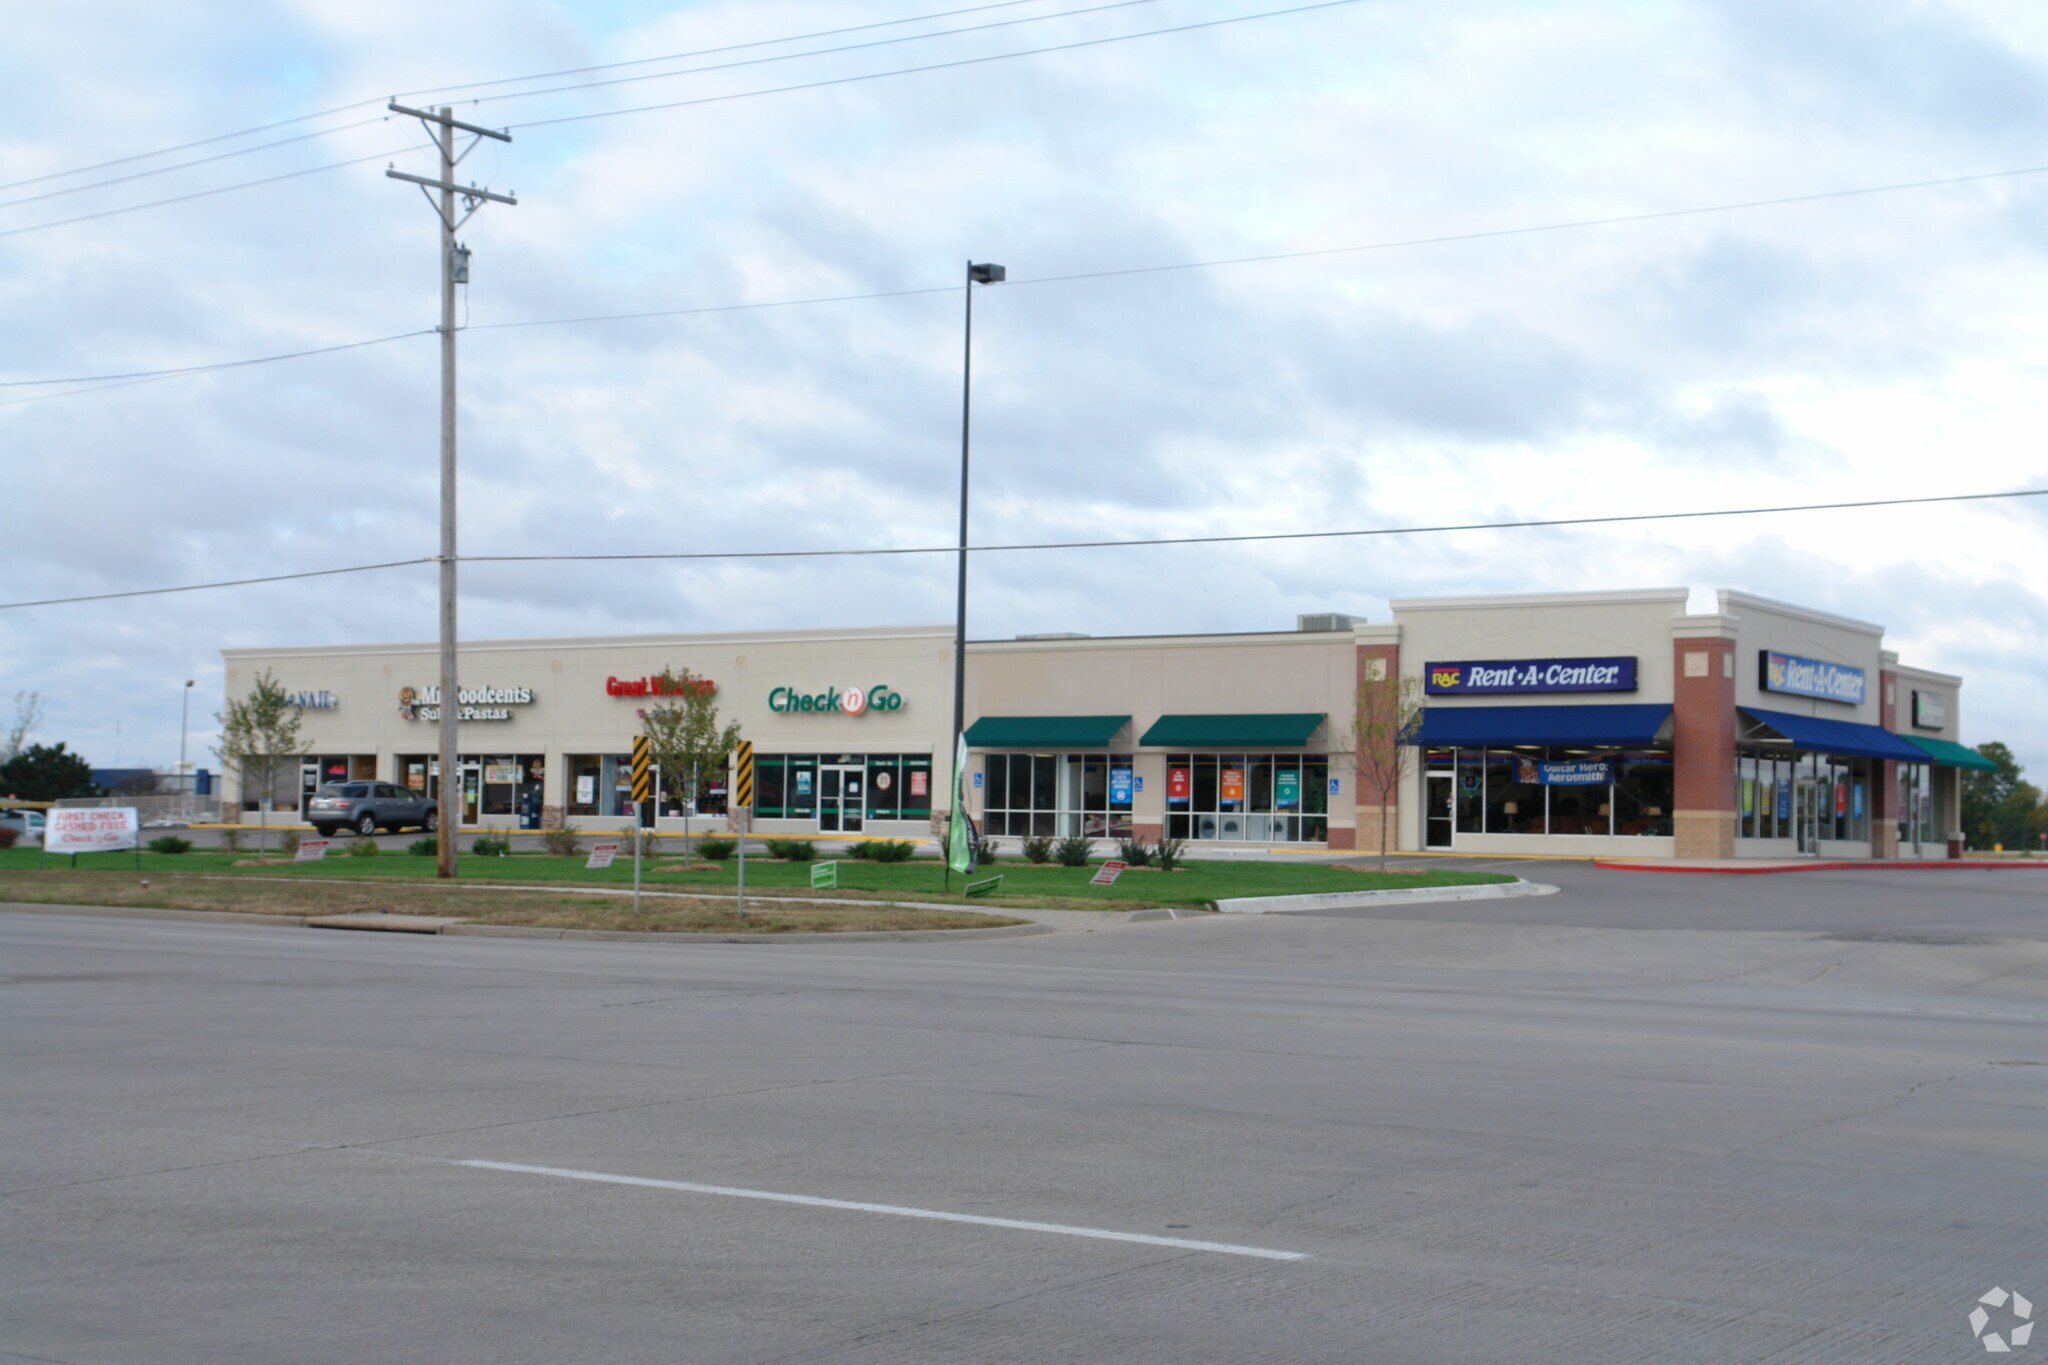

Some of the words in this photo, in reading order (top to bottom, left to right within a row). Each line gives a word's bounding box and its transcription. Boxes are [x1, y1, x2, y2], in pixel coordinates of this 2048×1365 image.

[1432, 672, 1460, 687] RAC
[606, 676, 647, 696] Great
[457, 685, 531, 704] oodcents
[768, 686, 842, 712] Check
[867, 684, 903, 711] Go
[464, 707, 508, 720] Pastas
[1544, 763, 1576, 773] Guitar
[1548, 771, 1605, 782] Aerosmith!
[57, 812, 85, 821] FIRST
[90, 812, 124, 821] CHECK
[55, 822, 96, 831] CASHED
[100, 821, 128, 830] FREE
[62, 833, 92, 843] Check
